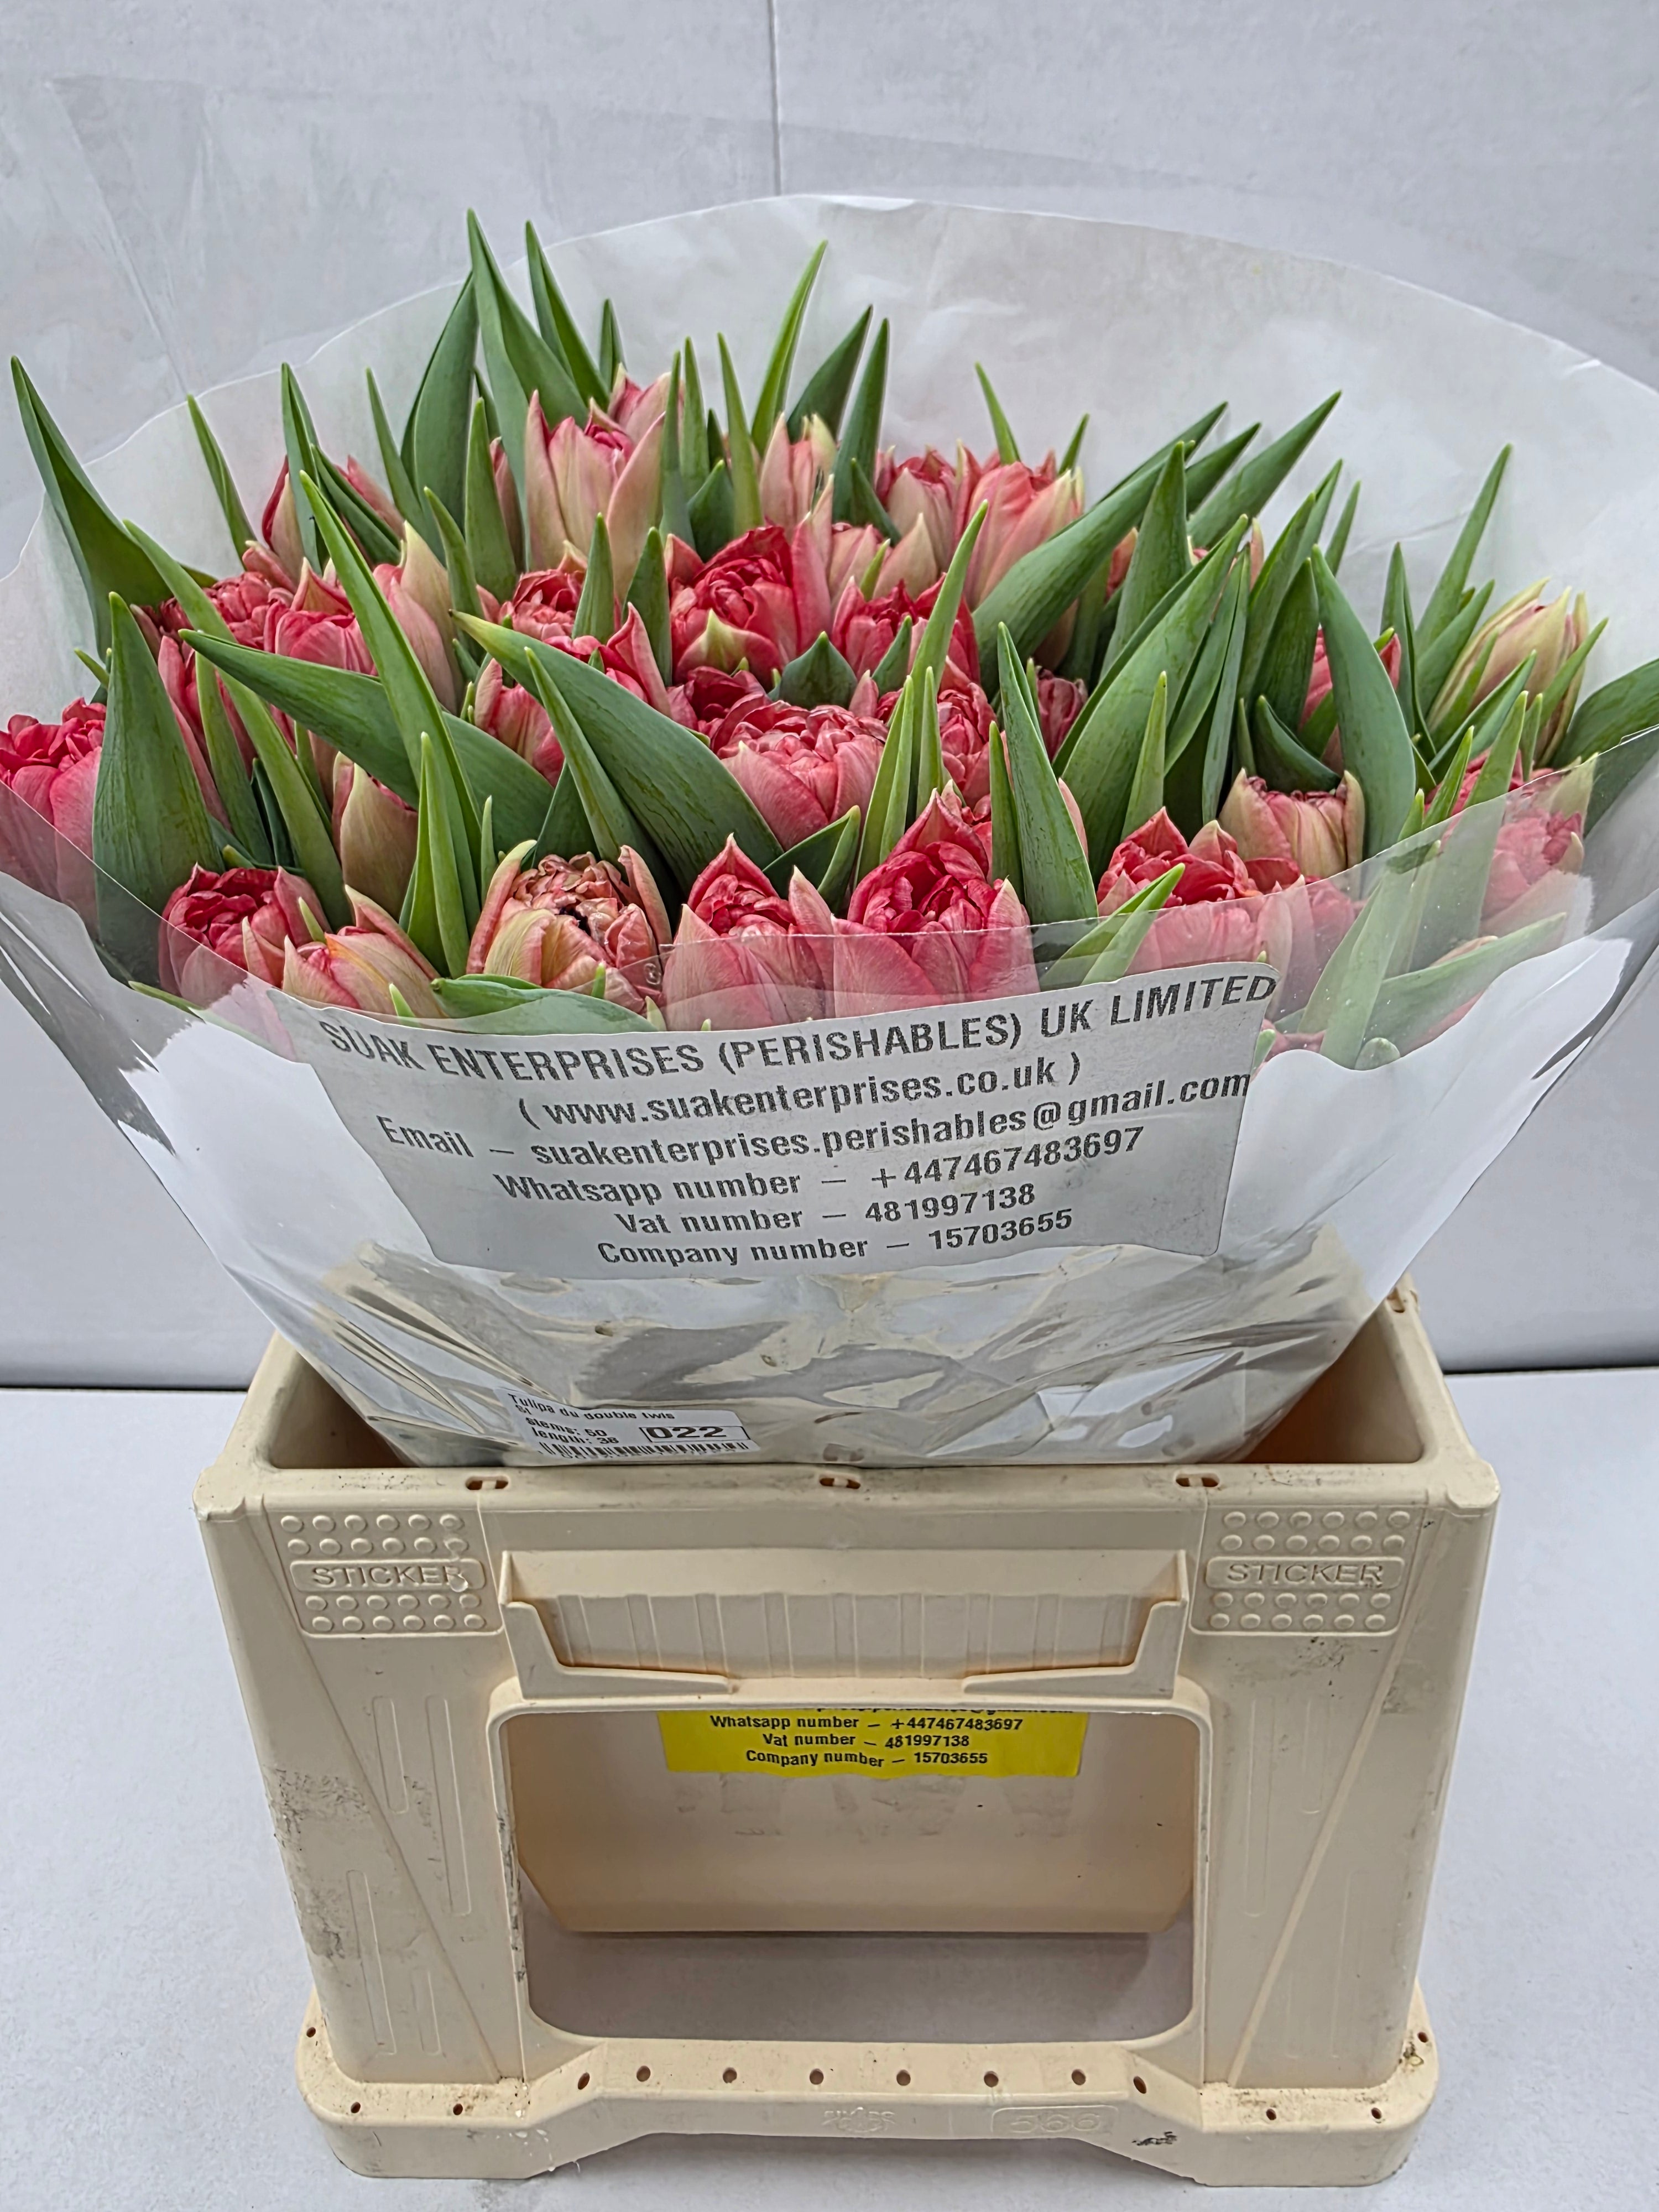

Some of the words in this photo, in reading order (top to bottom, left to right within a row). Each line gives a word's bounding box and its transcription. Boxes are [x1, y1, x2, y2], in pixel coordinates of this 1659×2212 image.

[319, 1020, 426, 1071] SUAK
[427, 1043, 704, 1081] ENTERPRISES
[719, 1012, 1022, 1075] (PERISHABLES)
[1041, 1000, 1094, 1038] UK
[1110, 975, 1276, 1026] LIMITED
[541, 1057, 1055, 1125] www.suakenterprises.co.uk
[377, 1115, 474, 1158] Email
[531, 1073, 1251, 1166] suakenterprises.perishables@gmail.com
[493, 1173, 662, 1206] Whatsapp
[672, 1171, 801, 1201] number
[871, 1126, 1145, 1189] +447467483697
[614, 1212, 671, 1235] Vat
[681, 1209, 802, 1233] number
[865, 1182, 1036, 1223] 481997138
[597, 1242, 739, 1267] Company
[750, 1238, 868, 1261] number
[928, 1208, 1073, 1250] 15703655
[508, 1393, 555, 1413] Tulipa
[559, 1407, 580, 1418] du
[583, 1411, 637, 1420] double
[525, 1417, 581, 1436] stems:
[645, 1426, 727, 1438] 022
[1227, 1563, 1383, 1587] STICKER
[710, 1715, 791, 1729] Whatsapp
[797, 1716, 859, 1728] number
[891, 1717, 1023, 1731] +447467483697
[763, 1734, 789, 1746] Vat
[794, 1734, 856, 1745] number
[885, 1735, 969, 1749] 481997138
[747, 1750, 818, 1767] Company
[824, 1752, 884, 1767] number
[914, 1752, 988, 1764] 15703655
